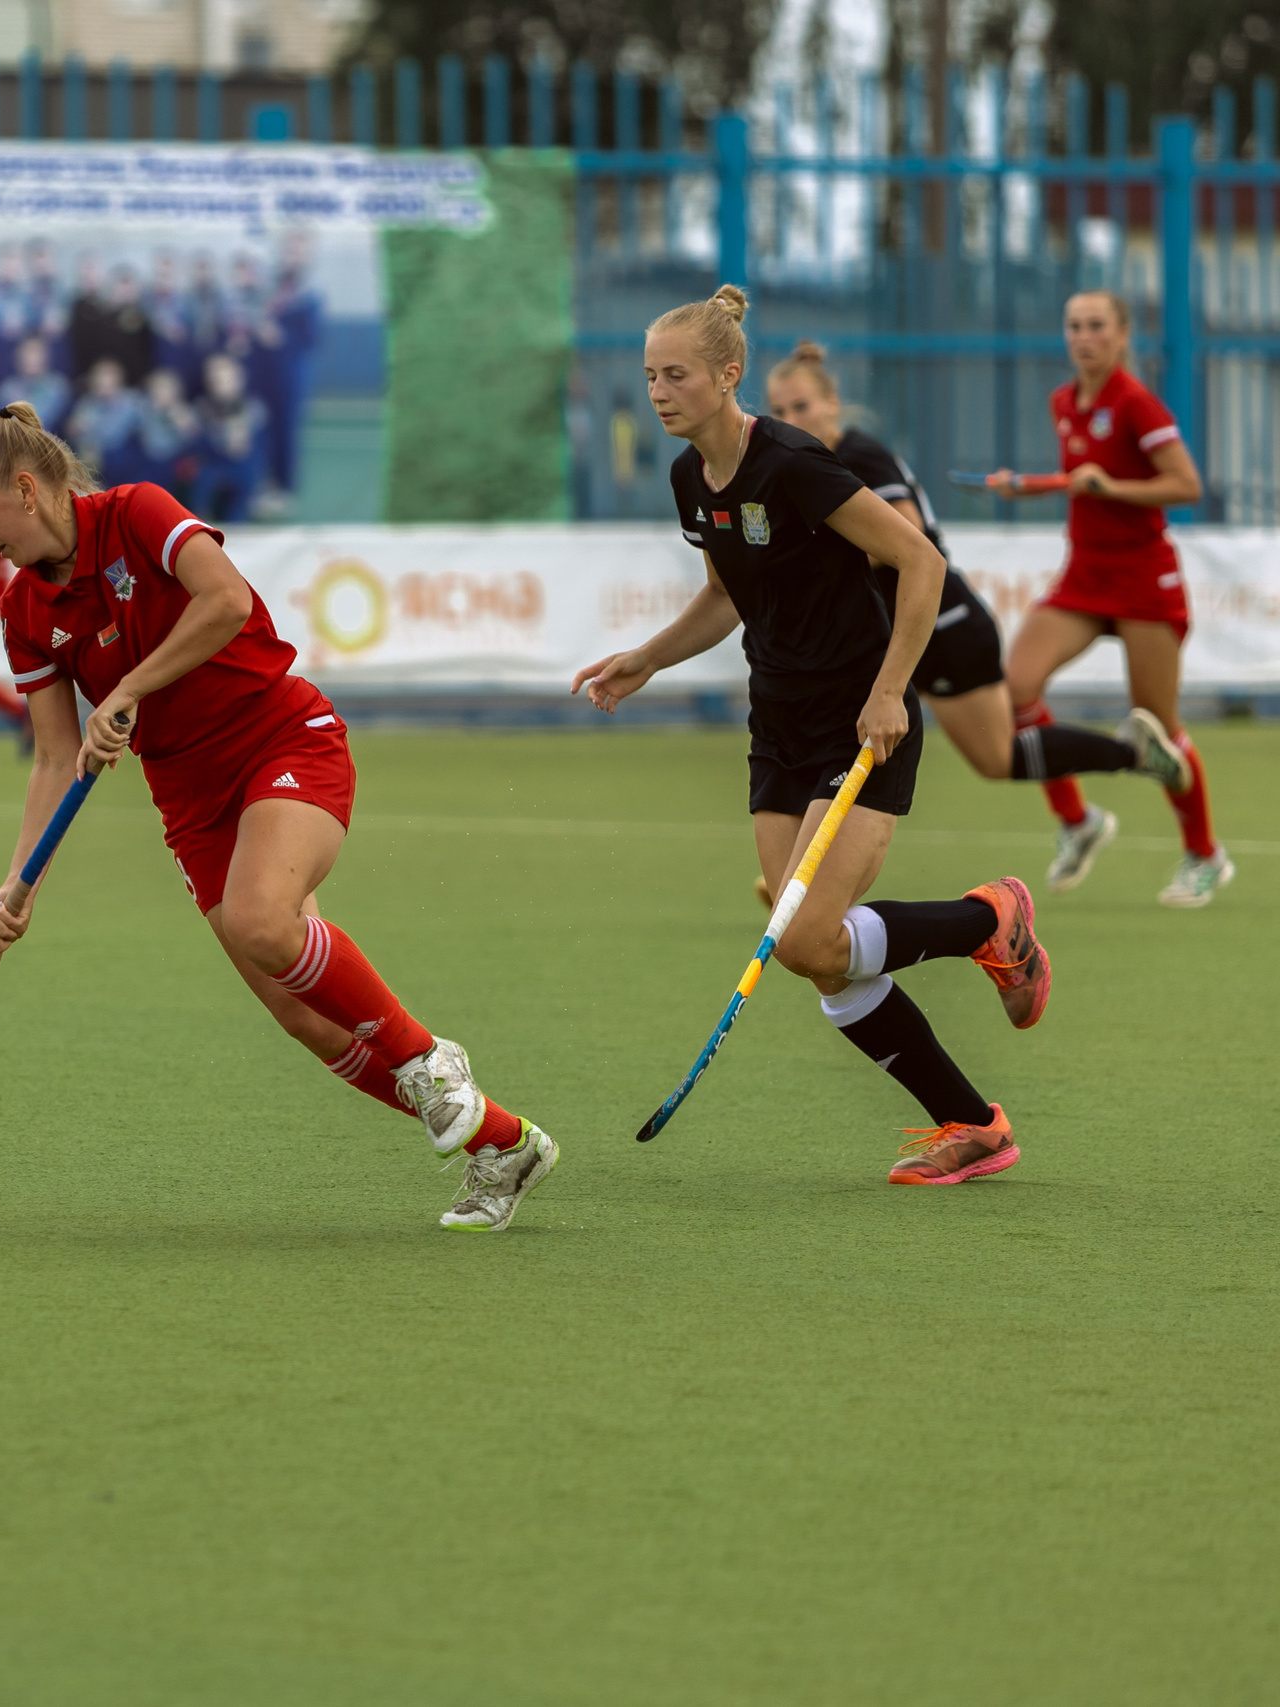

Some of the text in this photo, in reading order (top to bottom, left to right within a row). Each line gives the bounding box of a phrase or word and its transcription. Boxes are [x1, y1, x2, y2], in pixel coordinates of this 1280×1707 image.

[51, 633, 72, 648] adidas
[272, 781, 300, 789] adidas
[353, 1016, 386, 1040] adidas
